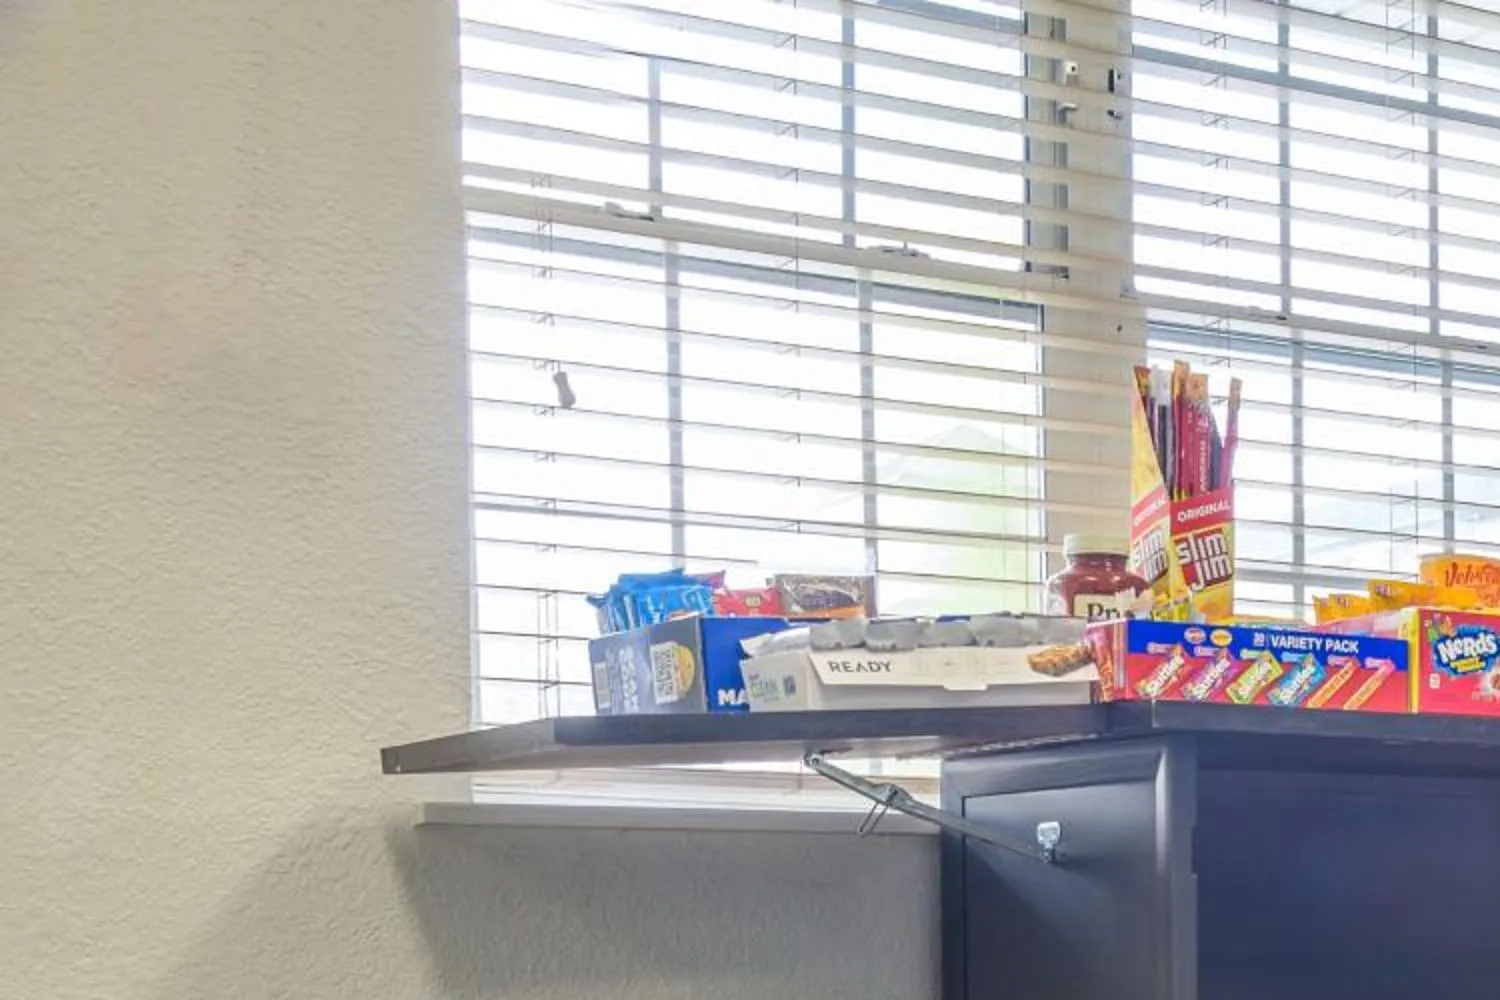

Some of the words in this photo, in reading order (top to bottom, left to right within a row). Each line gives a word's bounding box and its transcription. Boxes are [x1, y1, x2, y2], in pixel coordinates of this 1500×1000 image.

[1177, 501, 1231, 522] ORIGINAL
[1271, 631, 1323, 652] VARIETY
[1326, 638, 1359, 654] PACK
[827, 660, 893, 673] READY
